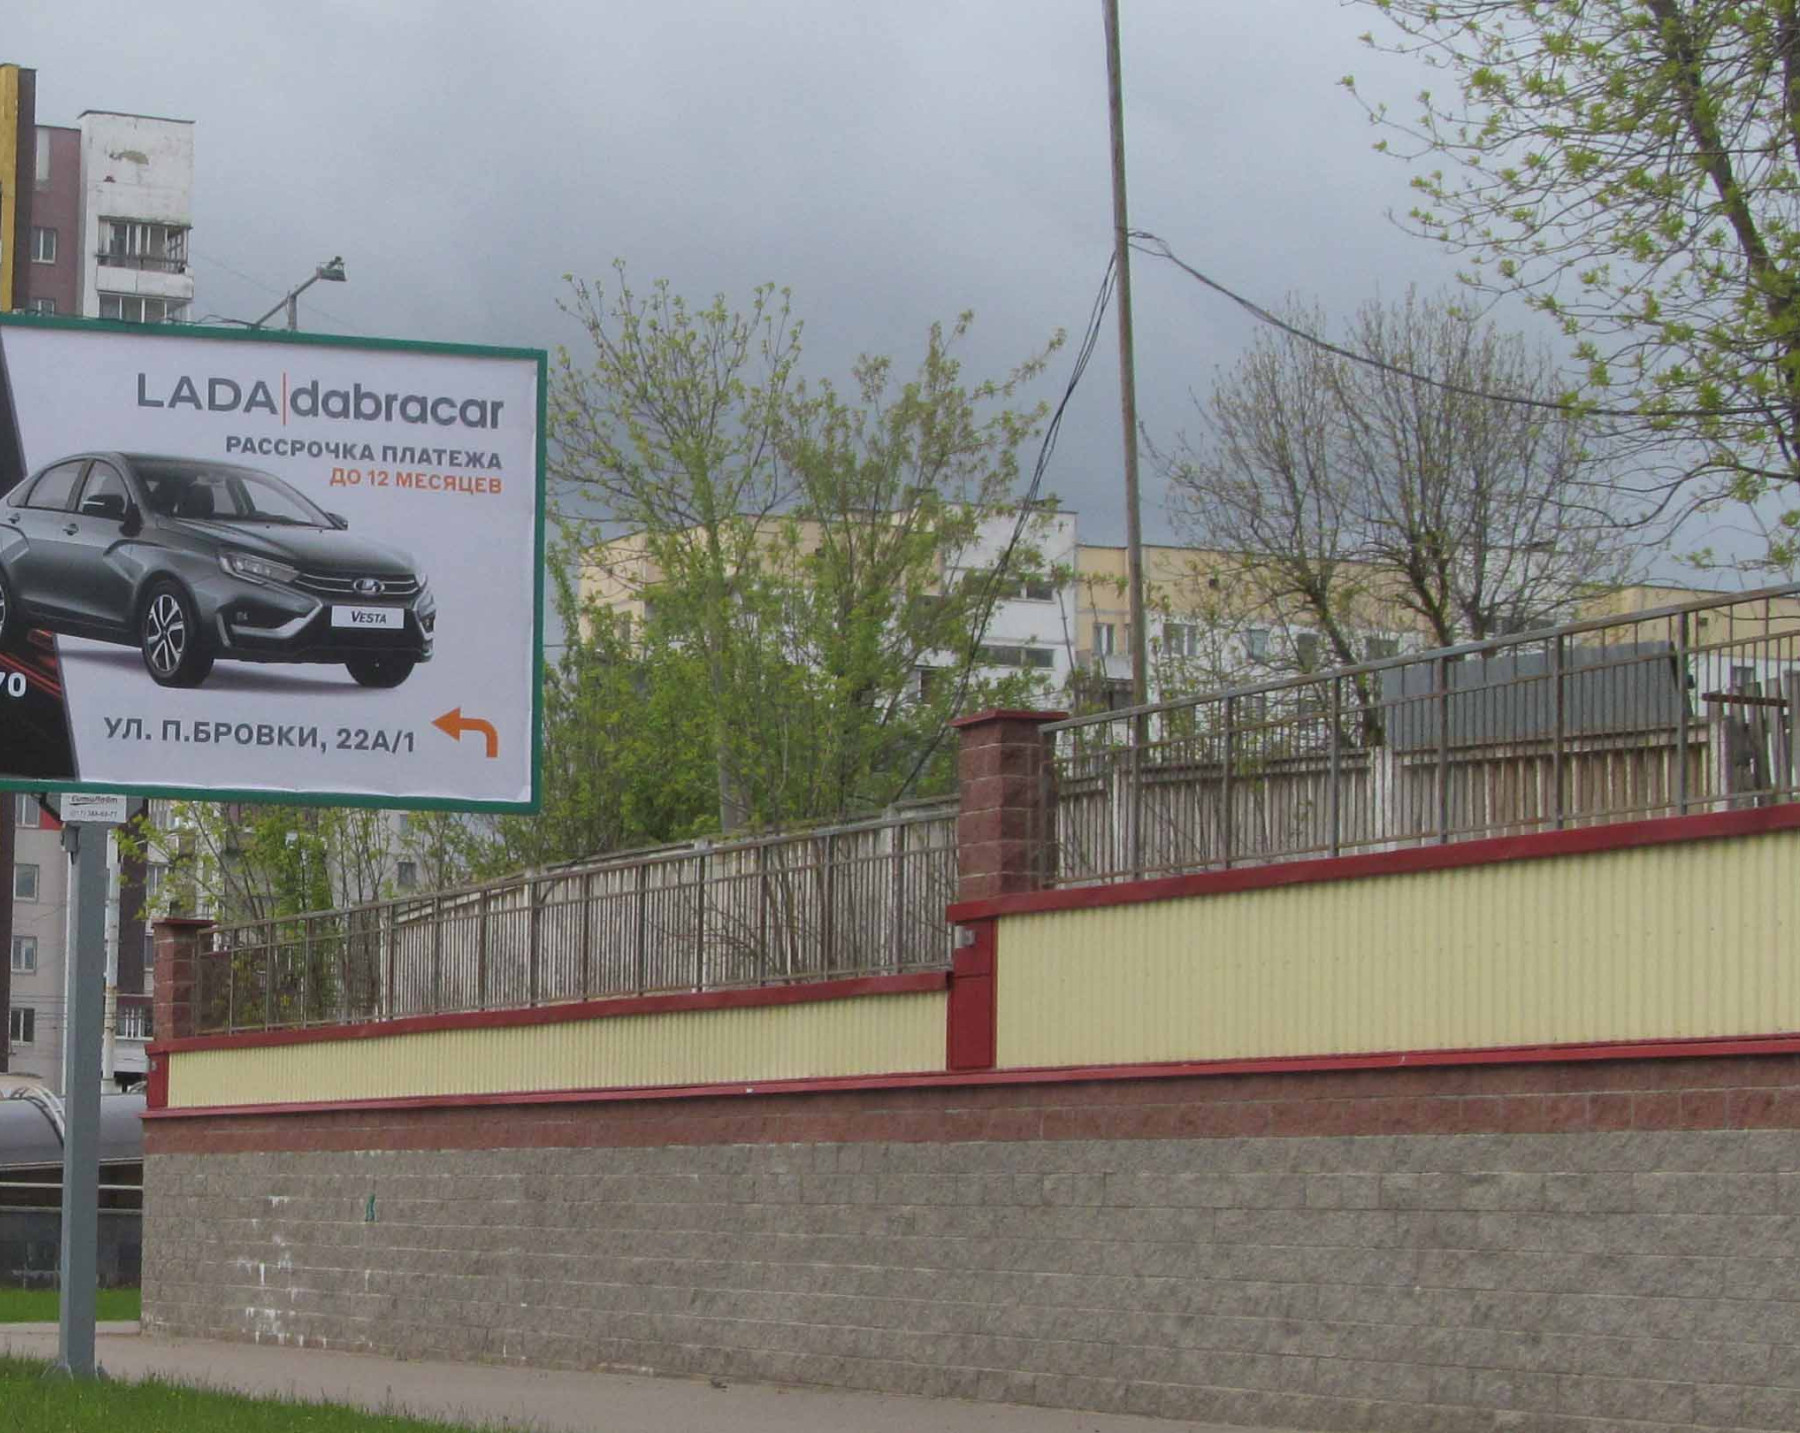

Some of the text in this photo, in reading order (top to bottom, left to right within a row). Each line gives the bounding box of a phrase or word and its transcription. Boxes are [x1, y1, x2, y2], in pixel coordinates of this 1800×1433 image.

[136, 372, 505, 430] LADA dabracar
[225, 435, 504, 470] РАССРОЧКА ПЛАТЕЖА
[329, 467, 504, 495] ДО 12 МЕСЯЦЕВ
[103, 717, 415, 756] УЛ. П.БРОВКИ, 22А/1
